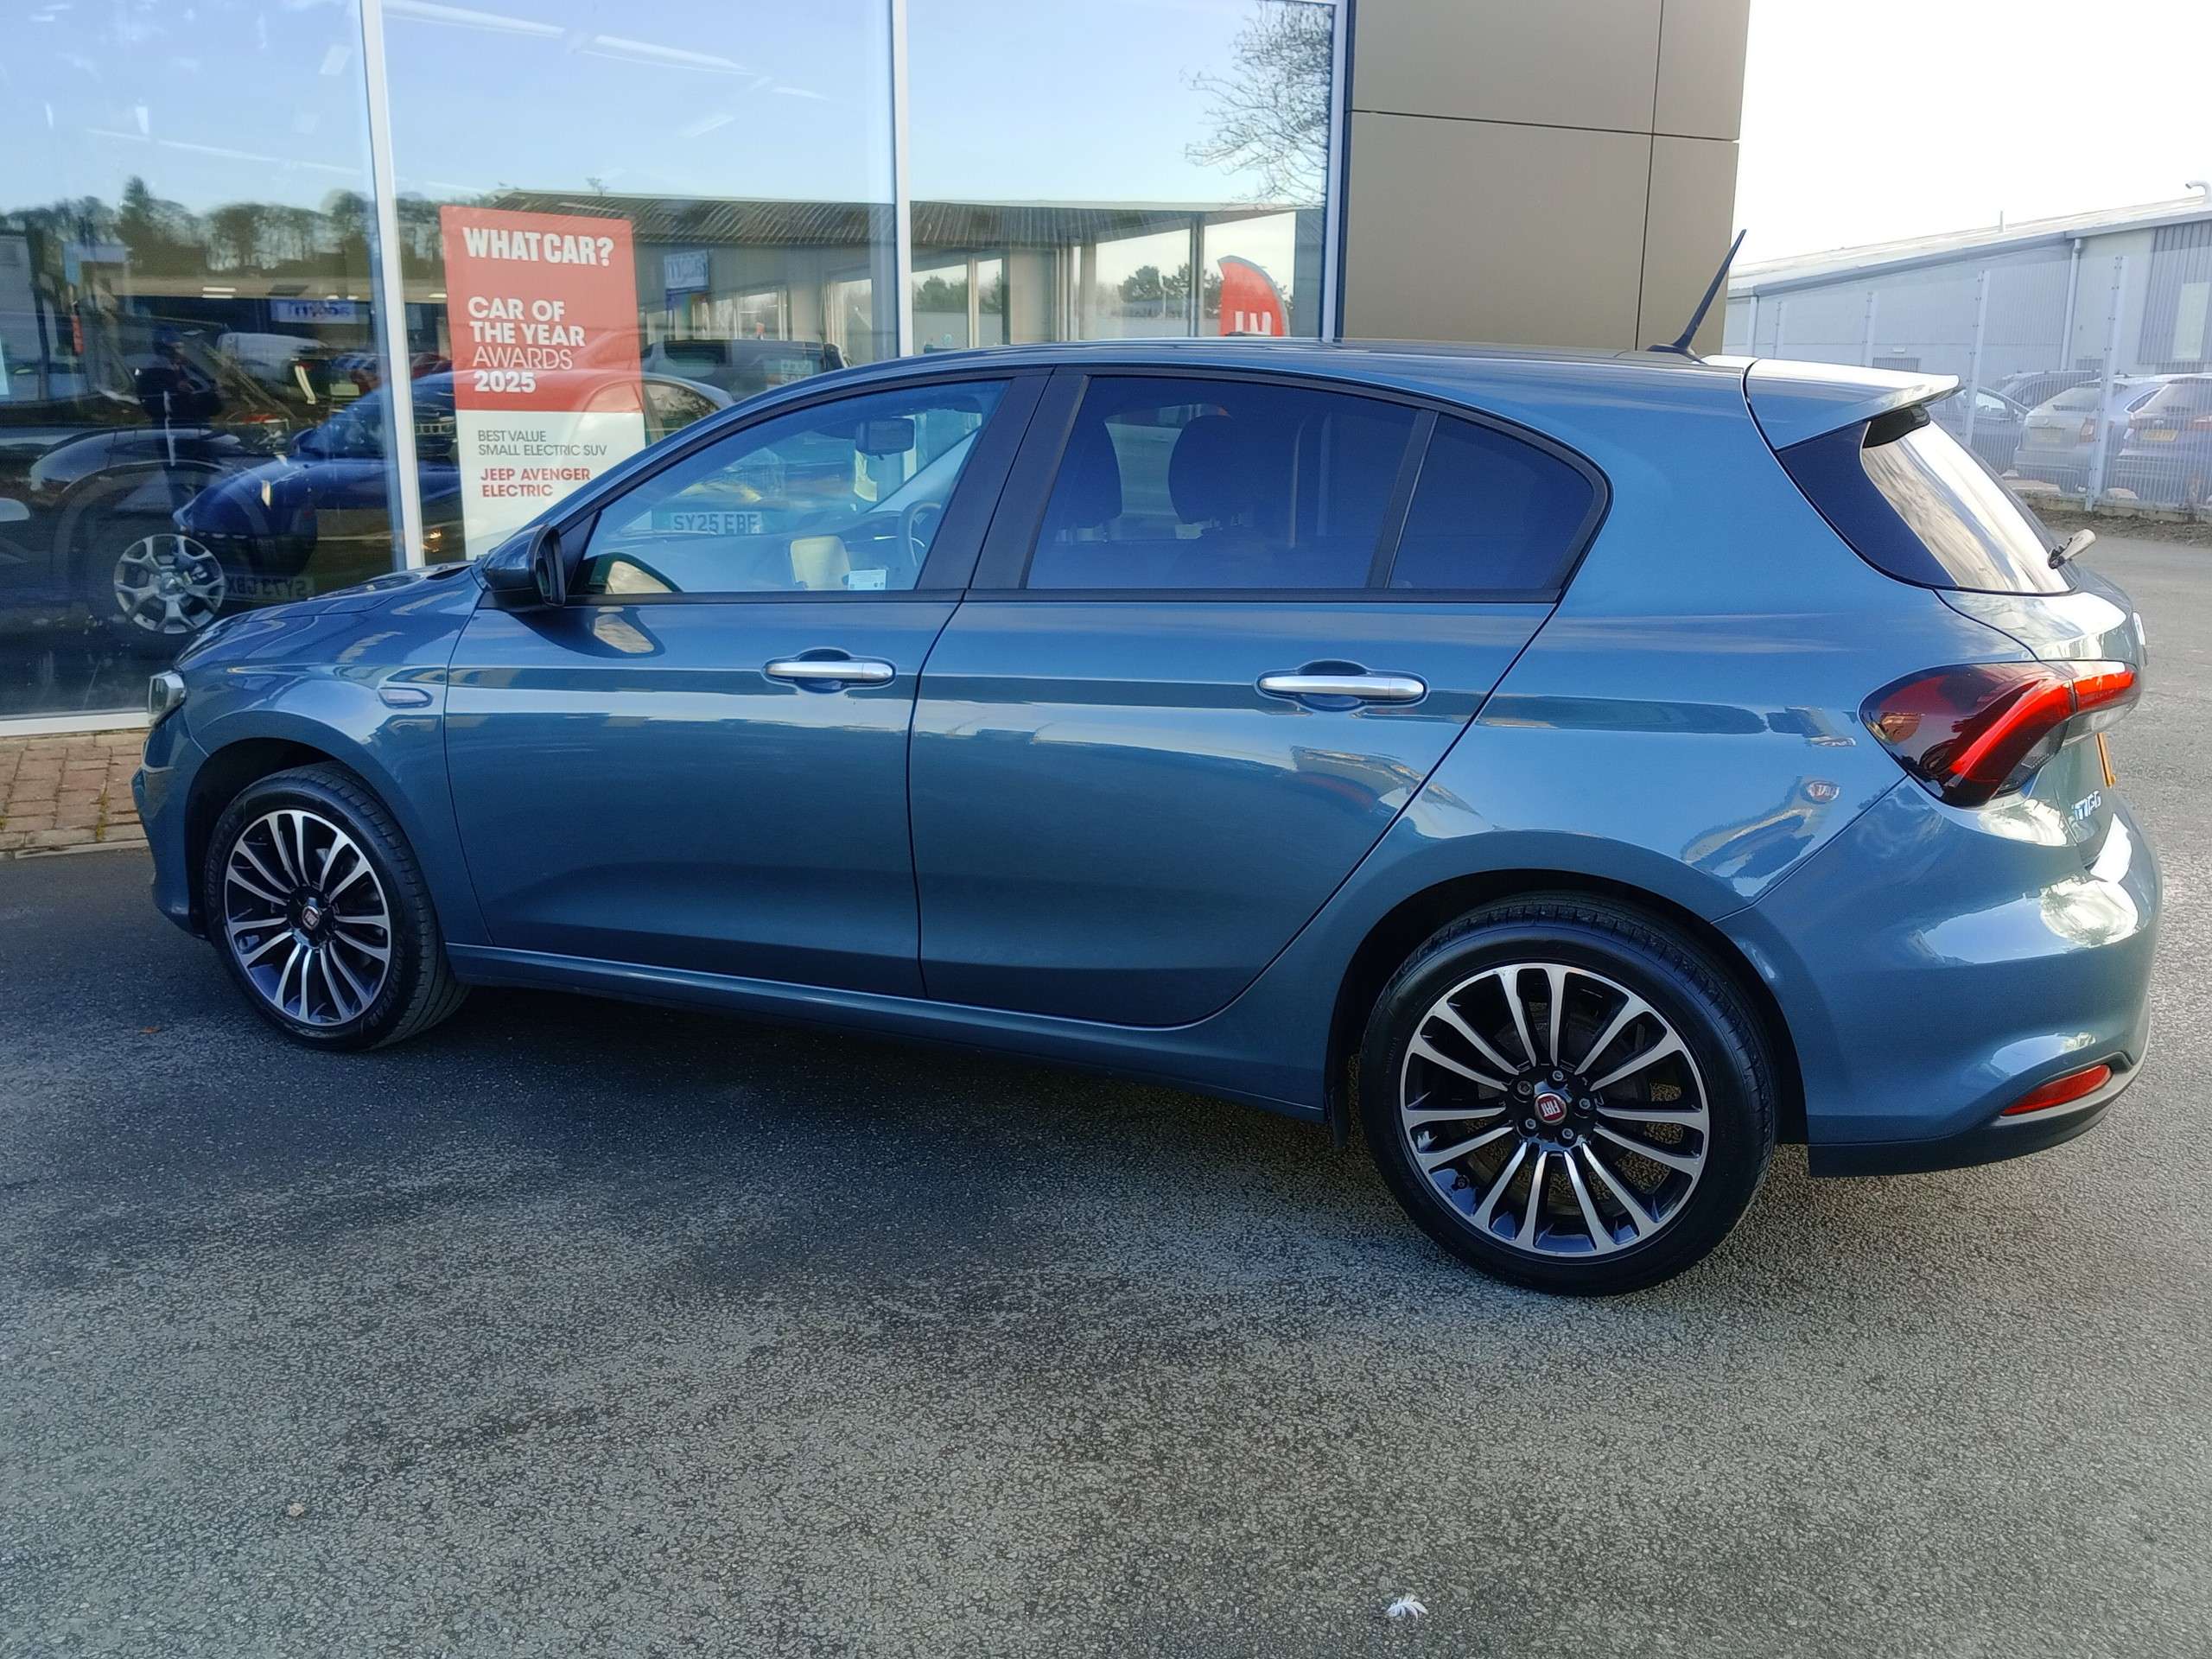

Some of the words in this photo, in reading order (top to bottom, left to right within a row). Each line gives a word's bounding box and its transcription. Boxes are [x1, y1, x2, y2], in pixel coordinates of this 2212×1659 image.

[462, 227, 540, 262] WHAT
[543, 232, 614, 267] CAR?
[468, 296, 524, 320] CAR
[531, 300, 565, 322] OF
[469, 321, 516, 344] THE
[520, 323, 586, 346] YEAR
[473, 346, 573, 370] AWARDS
[474, 371, 536, 393] 2025
[478, 429, 509, 442] BEST
[509, 430, 546, 442] VALUE
[478, 444, 521, 456] SMALL
[524, 444, 580, 456] ELECTRIC
[583, 445, 607, 456] SUV
[480, 468, 515, 481] JEEP
[520, 468, 591, 481] AVENGER
[481, 484, 554, 498] ELECTRIC
[674, 514, 719, 533] SY25
[1541, 1099, 1561, 1117] FIAT
